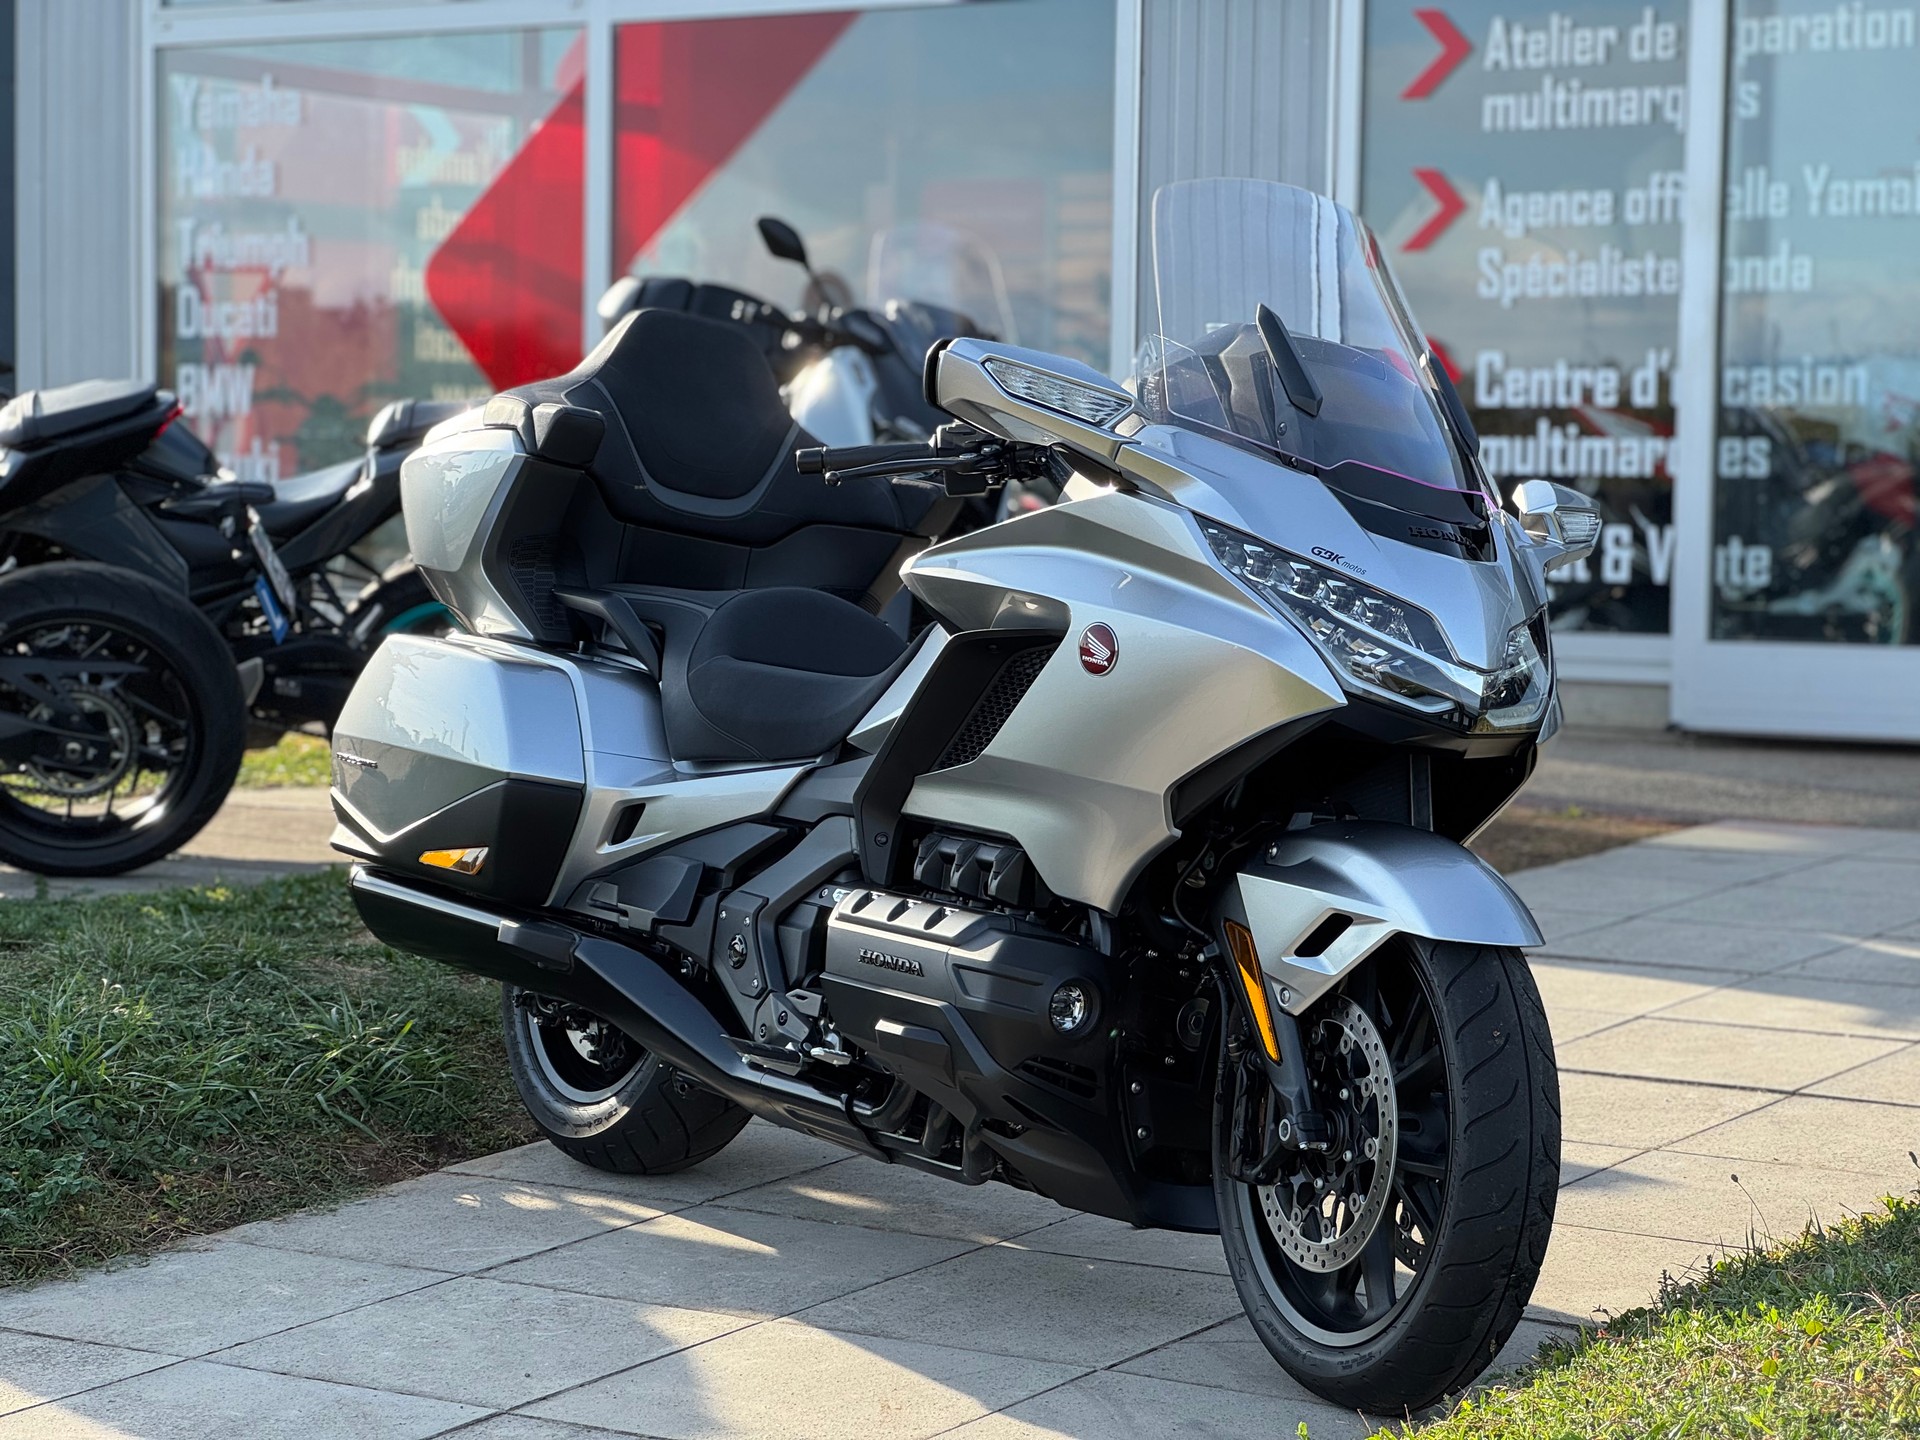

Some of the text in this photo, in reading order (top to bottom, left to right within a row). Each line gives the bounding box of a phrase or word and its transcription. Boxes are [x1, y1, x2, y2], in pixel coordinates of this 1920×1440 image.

[1482, 0, 1914, 72] Atelier de paration
[1479, 178, 1613, 239] Agence
[1477, 238, 1814, 309] Spécialiste onda
[177, 285, 278, 340] Ducati
[177, 362, 255, 417] BMW
[1475, 349, 1620, 409] Centre
[1311, 546, 1367, 576] GBK motos
[1603, 523, 1635, 585] &
[1081, 654, 1109, 668] HONDA
[858, 948, 925, 978] HONDA
